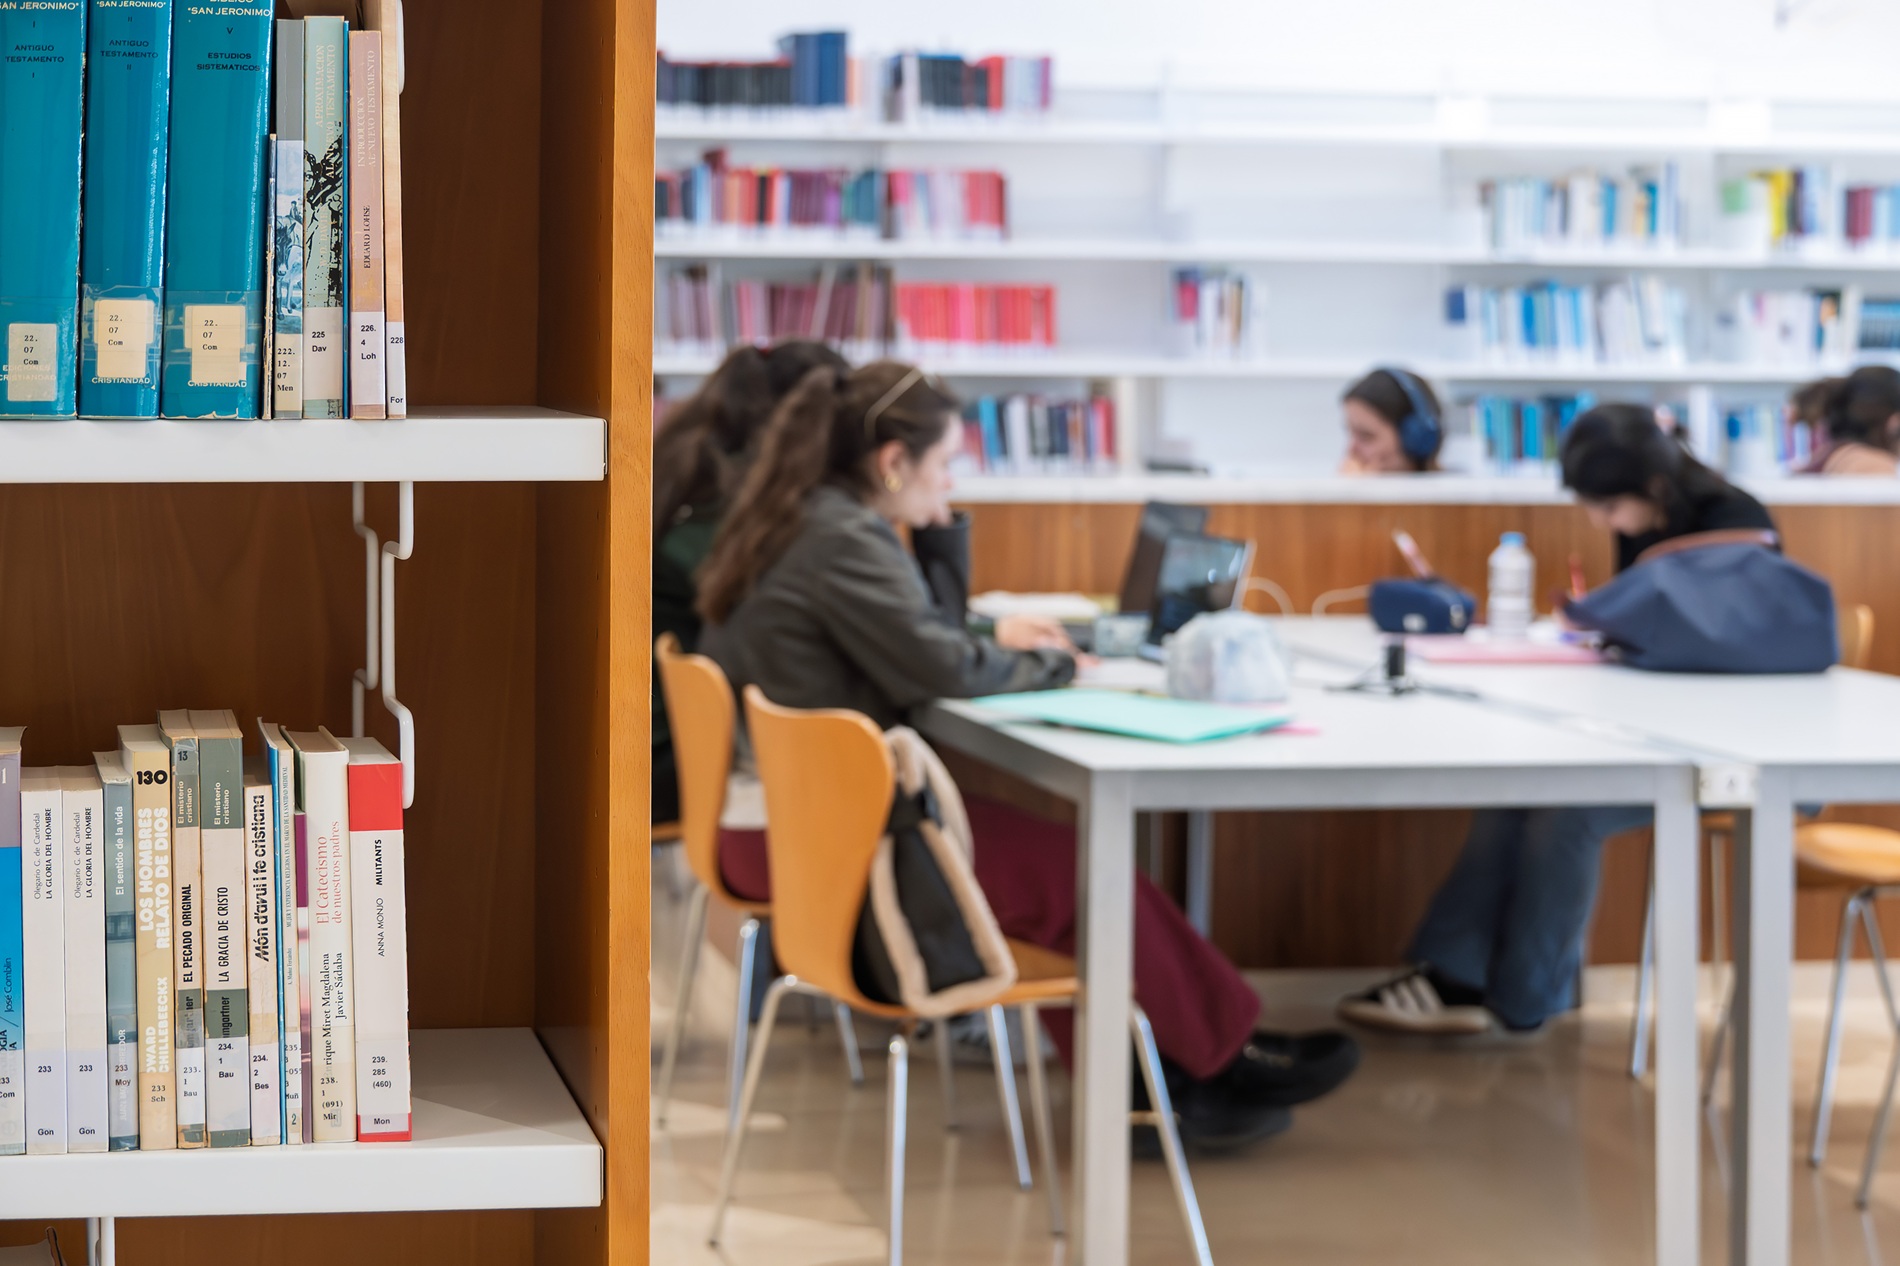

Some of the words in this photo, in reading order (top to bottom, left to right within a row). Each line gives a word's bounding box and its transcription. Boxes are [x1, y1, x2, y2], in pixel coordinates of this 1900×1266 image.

[226, 26, 234, 35] V
[14, 44, 55, 52] ANTIGUO
[109, 39, 149, 47] ANTIGUO
[5, 55, 65, 63] TESTAMENTO
[100, 50, 159, 59] TESTAMENTO
[207, 52, 252, 60] ESTUDIOS
[196, 63, 261, 72] SISTEMATICOS
[326, 44, 336, 118] TESTAMENTO
[367, 50, 376, 114] TESTAMENTO
[326, 163, 335, 178] AL
[363, 205, 371, 232] LOHSE
[363, 234, 371, 269] EDUARD
[109, 314, 123, 322] 22.
[204, 319, 218, 327] 22.
[108, 326, 119, 334] 07
[360, 324, 376, 332] 226.
[24, 334, 38, 342] 22.
[202, 331, 213, 339] 07
[390, 336, 404, 344] 228
[23, 346, 34, 354] 07
[361, 352, 377, 360] Loh
[91, 376, 150, 384] CRISTIANDAD
[276, 384, 294, 392] Men
[390, 396, 404, 404] For
[177, 750, 188, 761] 13
[136, 769, 168, 785] 130
[213, 782, 221, 815] misterio
[185, 787, 193, 823] cristiano
[222, 789, 230, 825] cristiano
[114, 805, 123, 826] vida
[177, 816, 184, 824] El
[214, 817, 221, 825] El
[115, 826, 123, 837] la
[153, 806, 169, 851] DIOS
[252, 794, 267, 858] cristiana
[115, 837, 124, 850] de
[330, 821, 343, 858] padres
[34, 846, 40, 857] de
[73, 846, 80, 856] de
[137, 807, 154, 893] HOMBRES
[114, 850, 124, 884] sentido
[155, 854, 169, 878] DE
[253, 860, 267, 875] fe
[374, 839, 383, 886] MILITANTS
[85, 857, 93, 887] GLORIA
[315, 835, 330, 909] Catecismo
[34, 868, 43, 900] Olegario
[74, 867, 83, 899] Olegario
[331, 857, 342, 909] nuestros
[46, 888, 52, 899] LA
[86, 888, 93, 899] LA
[115, 886, 124, 896] El
[181, 883, 192, 927] ORIGINAL
[217, 886, 229, 917] CRISTO
[139, 897, 154, 932] LOS
[155, 882, 170, 949] RELATO
[316, 913, 329, 924] El
[332, 910, 342, 924] de
[376, 897, 384, 929] MONJO
[217, 919, 229, 932] DE
[182, 930, 193, 969] PECADO
[253, 927, 269, 962] Món
[218, 935, 229, 968] GRACIA
[4, 957, 13, 993] Comblin
[333, 952, 343, 988] Sádaba
[183, 970, 193, 983] EL
[218, 970, 229, 982] LA
[320, 953, 335, 1007] Magdalena
[4, 994, 14, 1013] José
[335, 989, 347, 1019] Javier
[220, 996, 233, 1039] mgartner
[157, 977, 169, 1073] CHILLEBEECKX
[321, 1007, 331, 1042] Miret
[146, 1026, 157, 1073] DWARD
[218, 1043, 234, 1051] 234.
[218, 1057, 223, 1065] 1
[252, 1055, 268, 1063] 234.
[37, 1065, 52, 1073] 233
[78, 1064, 93, 1072] 233
[114, 1064, 129, 1072] 233
[183, 1066, 201, 1074] 233.
[372, 1068, 386, 1076] 285
[0, 1076, 11, 1085] 33
[115, 1078, 131, 1087] Moy
[254, 1082, 269, 1090] Bes
[320, 1077, 338, 1085] 238.
[372, 1080, 392, 1088] (460)
[151, 1095, 166, 1103] Sch
[321, 1100, 343, 1109] (091)
[291, 1113, 297, 1125] 2
[373, 1117, 390, 1125] Mon
[37, 1128, 54, 1136] Gon
[78, 1127, 95, 1135] Gon
